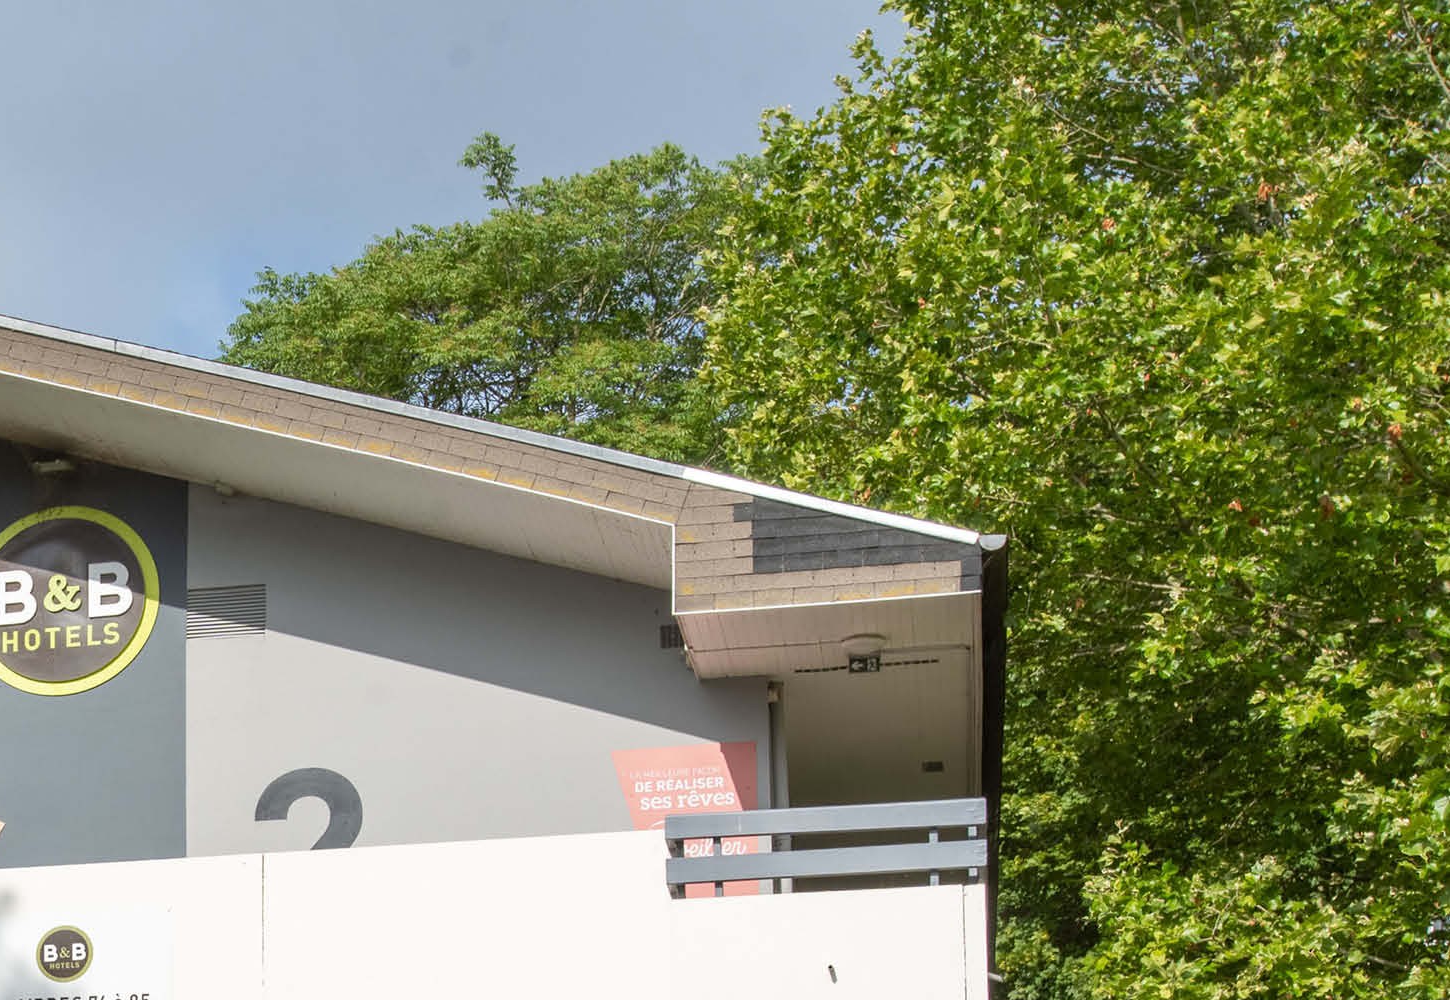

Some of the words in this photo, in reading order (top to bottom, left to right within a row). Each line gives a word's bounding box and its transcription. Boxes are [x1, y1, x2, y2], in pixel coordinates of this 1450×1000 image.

[1, 622, 120, 654] HOTELS
[634, 781, 653, 793] DE
[254, 767, 363, 851] 2
[640, 795, 672, 810] ses
[677, 790, 735, 808] rêves
[43, 943, 87, 962] B&B
[50, 962, 80, 970] HOTELS
